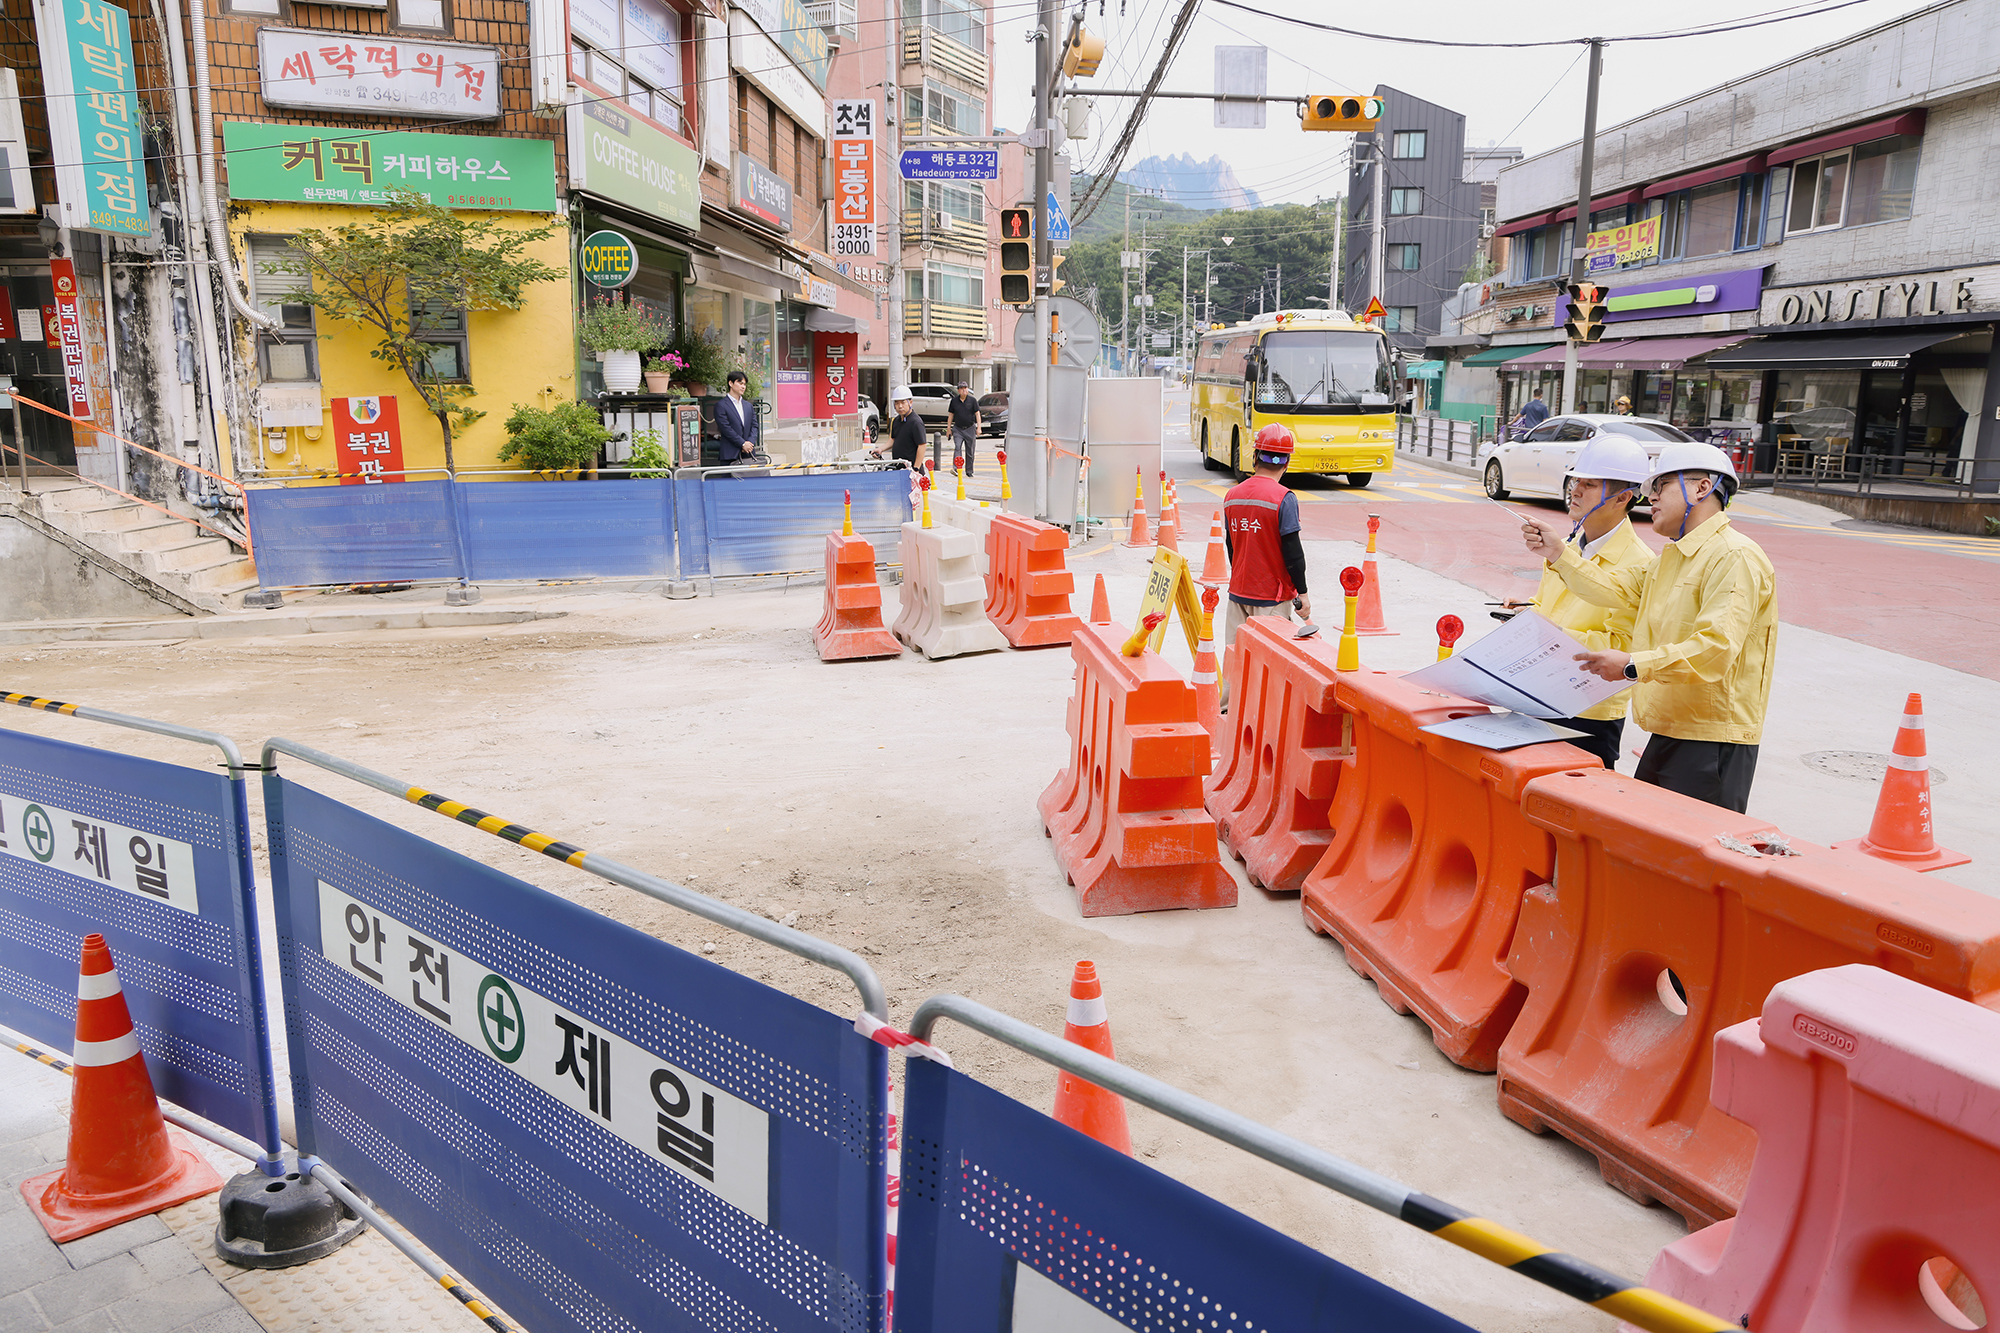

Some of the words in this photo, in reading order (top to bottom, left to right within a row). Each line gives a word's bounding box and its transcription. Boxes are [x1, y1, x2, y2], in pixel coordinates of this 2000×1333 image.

[281, 44, 485, 101] 세탁편의점
[76, 0, 138, 214] 세탁편의점
[836, 103, 870, 135] 초석
[282, 137, 373, 185] 커픽
[383, 153, 511, 182] 커피하우스
[593, 131, 639, 179] COFFEE
[642, 155, 676, 196] HOUSE
[931, 152, 995, 167] 해등로32길
[970, 168, 995, 179] 32-gil
[302, 187, 348, 201] 원두판매
[758, 172, 786, 212] 복권판매점
[839, 143, 869, 220] 부동산
[91, 210, 149, 233] 3491-4834
[837, 225, 872, 239] 3491-
[1616, 220, 1656, 253] 임대
[584, 246, 630, 272] COFFEE
[838, 240, 870, 254] 9000
[60, 303, 87, 403] 복권판매점
[826, 345, 847, 406] 부동산
[347, 430, 391, 455] 복권
[359, 459, 384, 484] 판
[1320, 462, 1339, 470] 3965
[1231, 518, 1262, 534] 신호수
[1918, 791, 1930, 834] 치수과
[72, 819, 170, 900] 제일
[1881, 927, 1933, 953] RB-3000
[345, 902, 452, 1026] 안전
[555, 1013, 714, 1183] 제일
[1798, 1019, 1854, 1053] RB-3000
